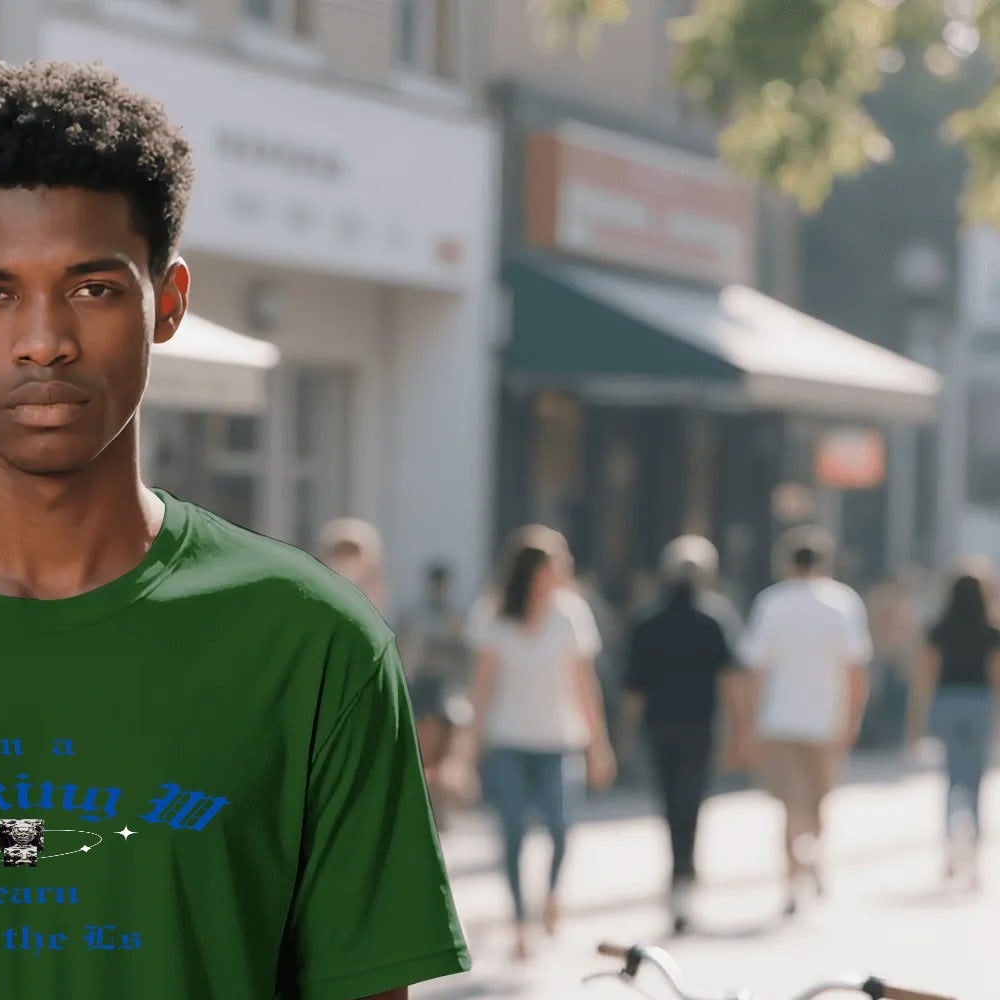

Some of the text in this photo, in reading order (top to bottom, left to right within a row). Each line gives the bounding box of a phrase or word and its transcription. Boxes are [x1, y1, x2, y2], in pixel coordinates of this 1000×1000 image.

[51, 737, 76, 757] a
[138, 781, 231, 832] W
[1, 924, 69, 956] the
[82, 923, 143, 951] Ls
